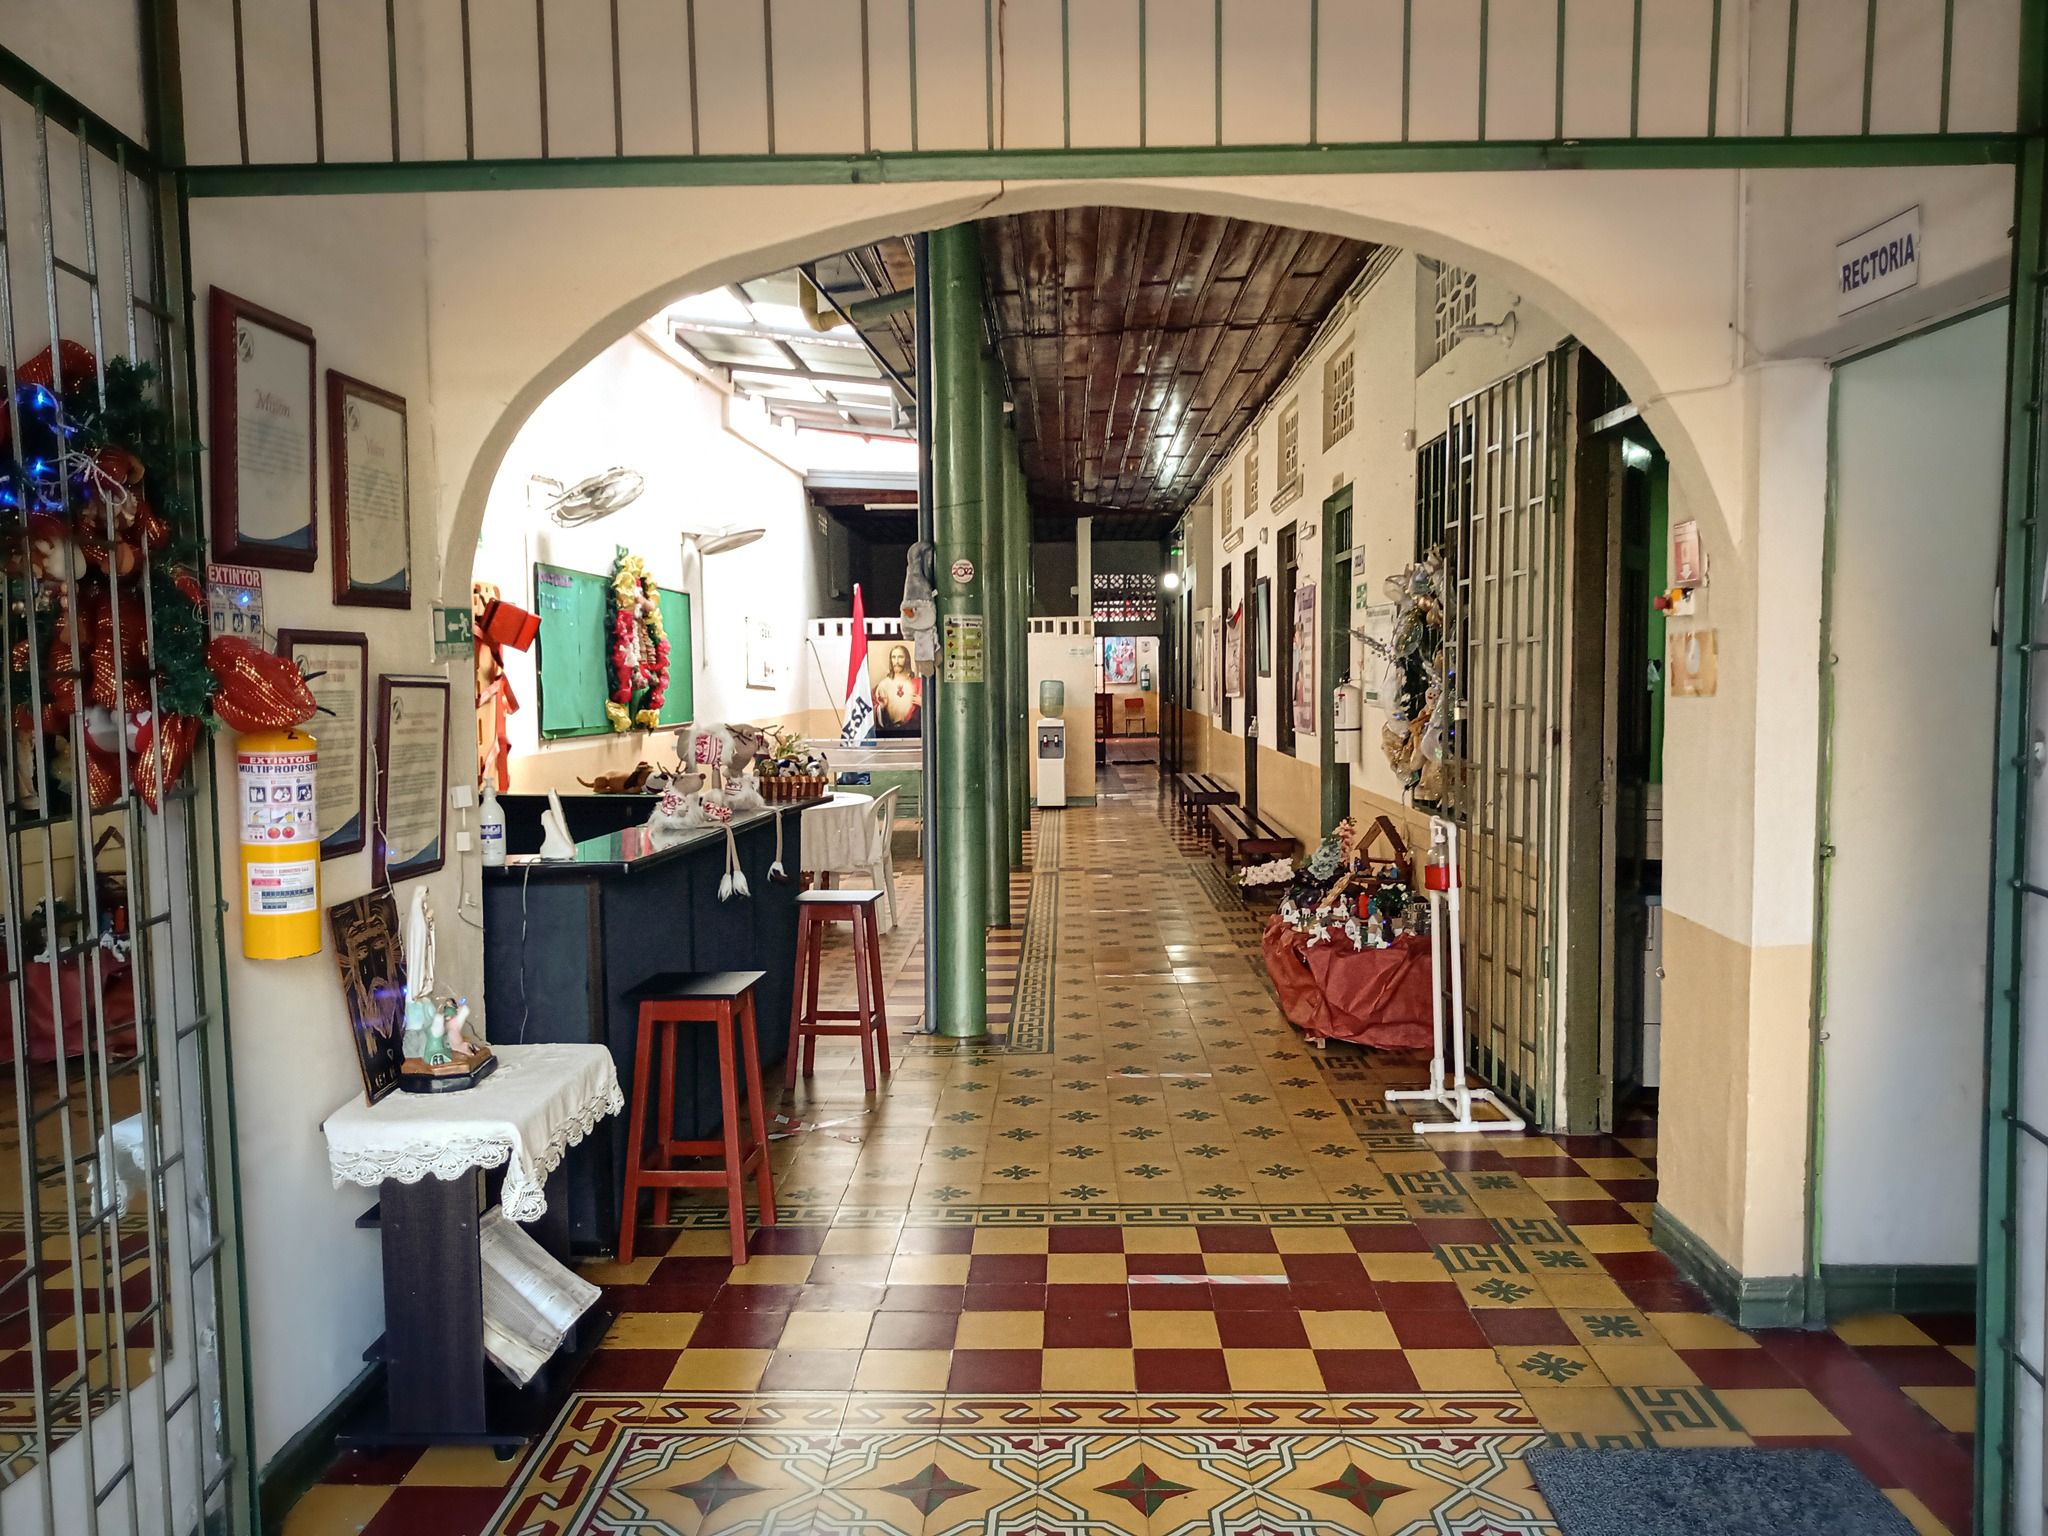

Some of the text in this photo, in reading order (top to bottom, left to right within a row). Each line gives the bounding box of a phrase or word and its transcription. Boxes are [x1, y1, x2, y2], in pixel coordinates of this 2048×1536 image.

[1842, 233, 1915, 294] RECTORIA
[208, 565, 260, 587] EXTINTOR
[249, 755, 310, 764] EXTINTOR
